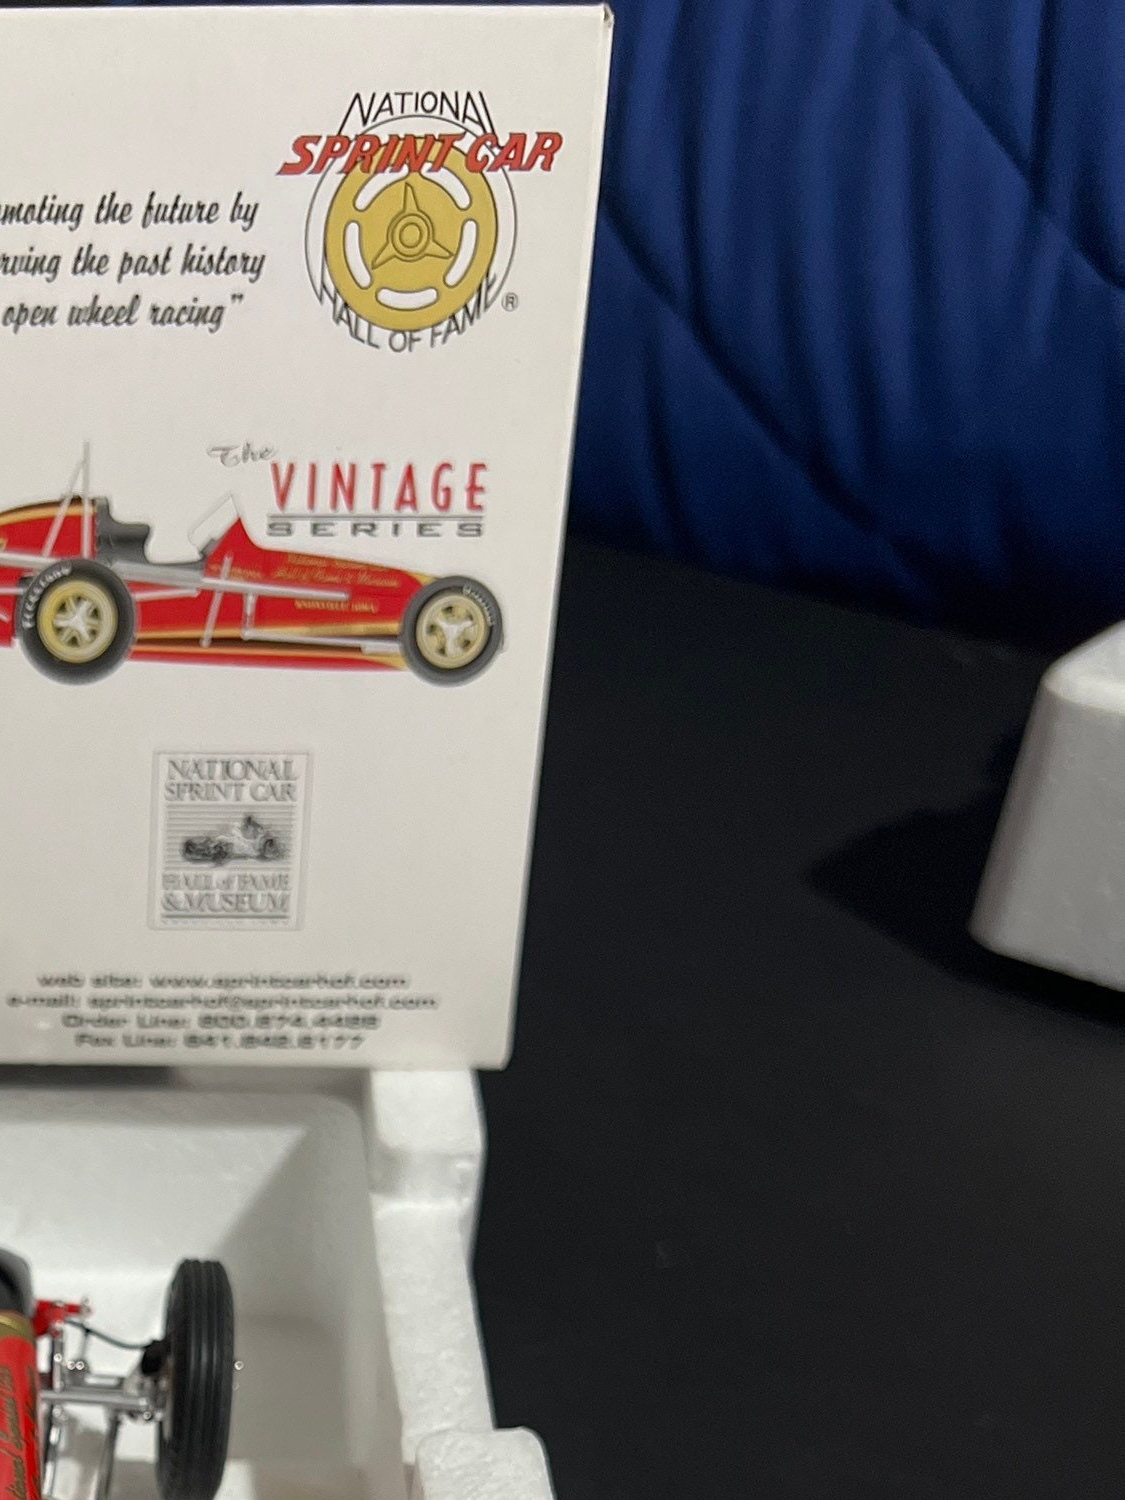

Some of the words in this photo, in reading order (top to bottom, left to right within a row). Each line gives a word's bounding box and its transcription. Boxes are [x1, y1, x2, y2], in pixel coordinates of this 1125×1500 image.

[276, 133, 465, 176] SPRINT
[464, 131, 564, 174] CAR
[95, 191, 132, 225] the
[140, 191, 220, 231] future
[229, 192, 261, 232] by
[73, 241, 111, 277] the
[117, 246, 171, 281] past
[179, 245, 266, 284] history
[1, 300, 58, 330] open
[67, 294, 141, 329] wheel
[388, 330, 423, 353] OF
[431, 272, 498, 349] FAME
[207, 442, 276, 468] The
[270, 462, 488, 513] VINTAGE
[266, 522, 484, 538] SERIES
